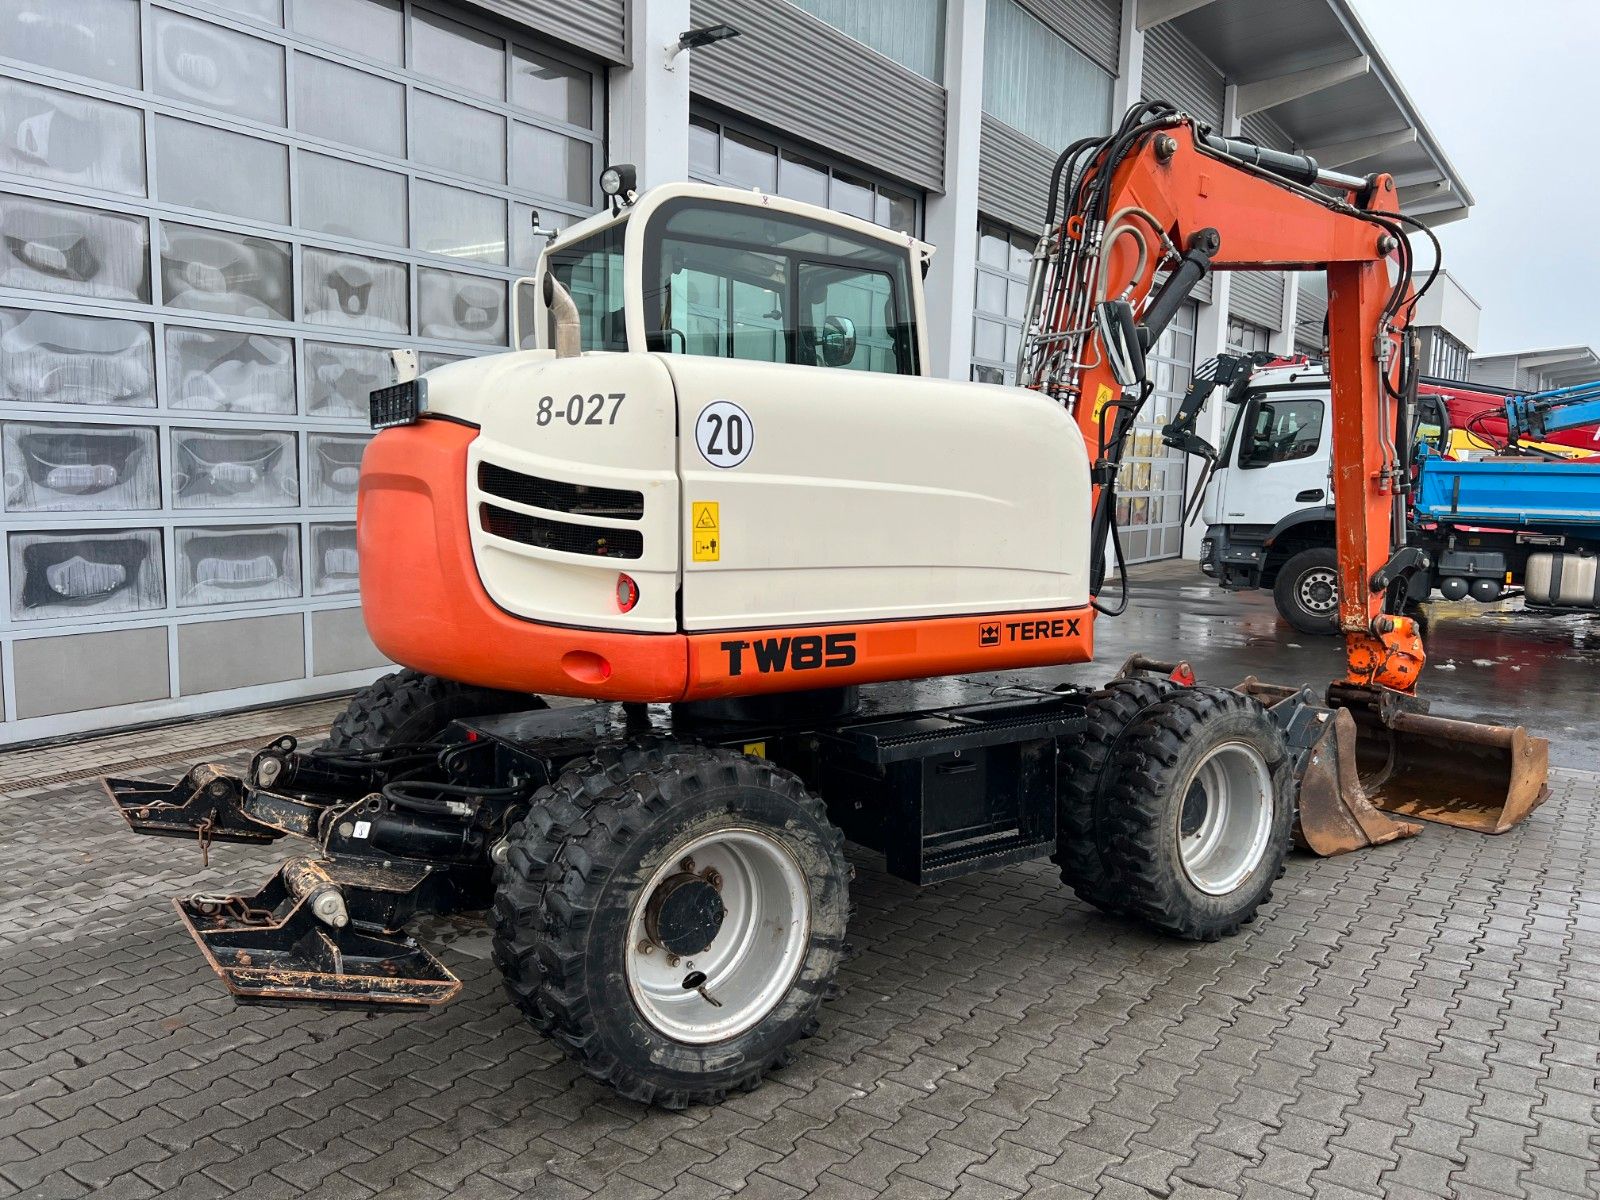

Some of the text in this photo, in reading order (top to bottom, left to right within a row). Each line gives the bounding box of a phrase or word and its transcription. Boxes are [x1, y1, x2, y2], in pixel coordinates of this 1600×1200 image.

[536, 393, 626, 427] 8-027
[706, 413, 743, 456] 20
[1005, 618, 1081, 642] TEREX
[720, 632, 857, 676] TW85
